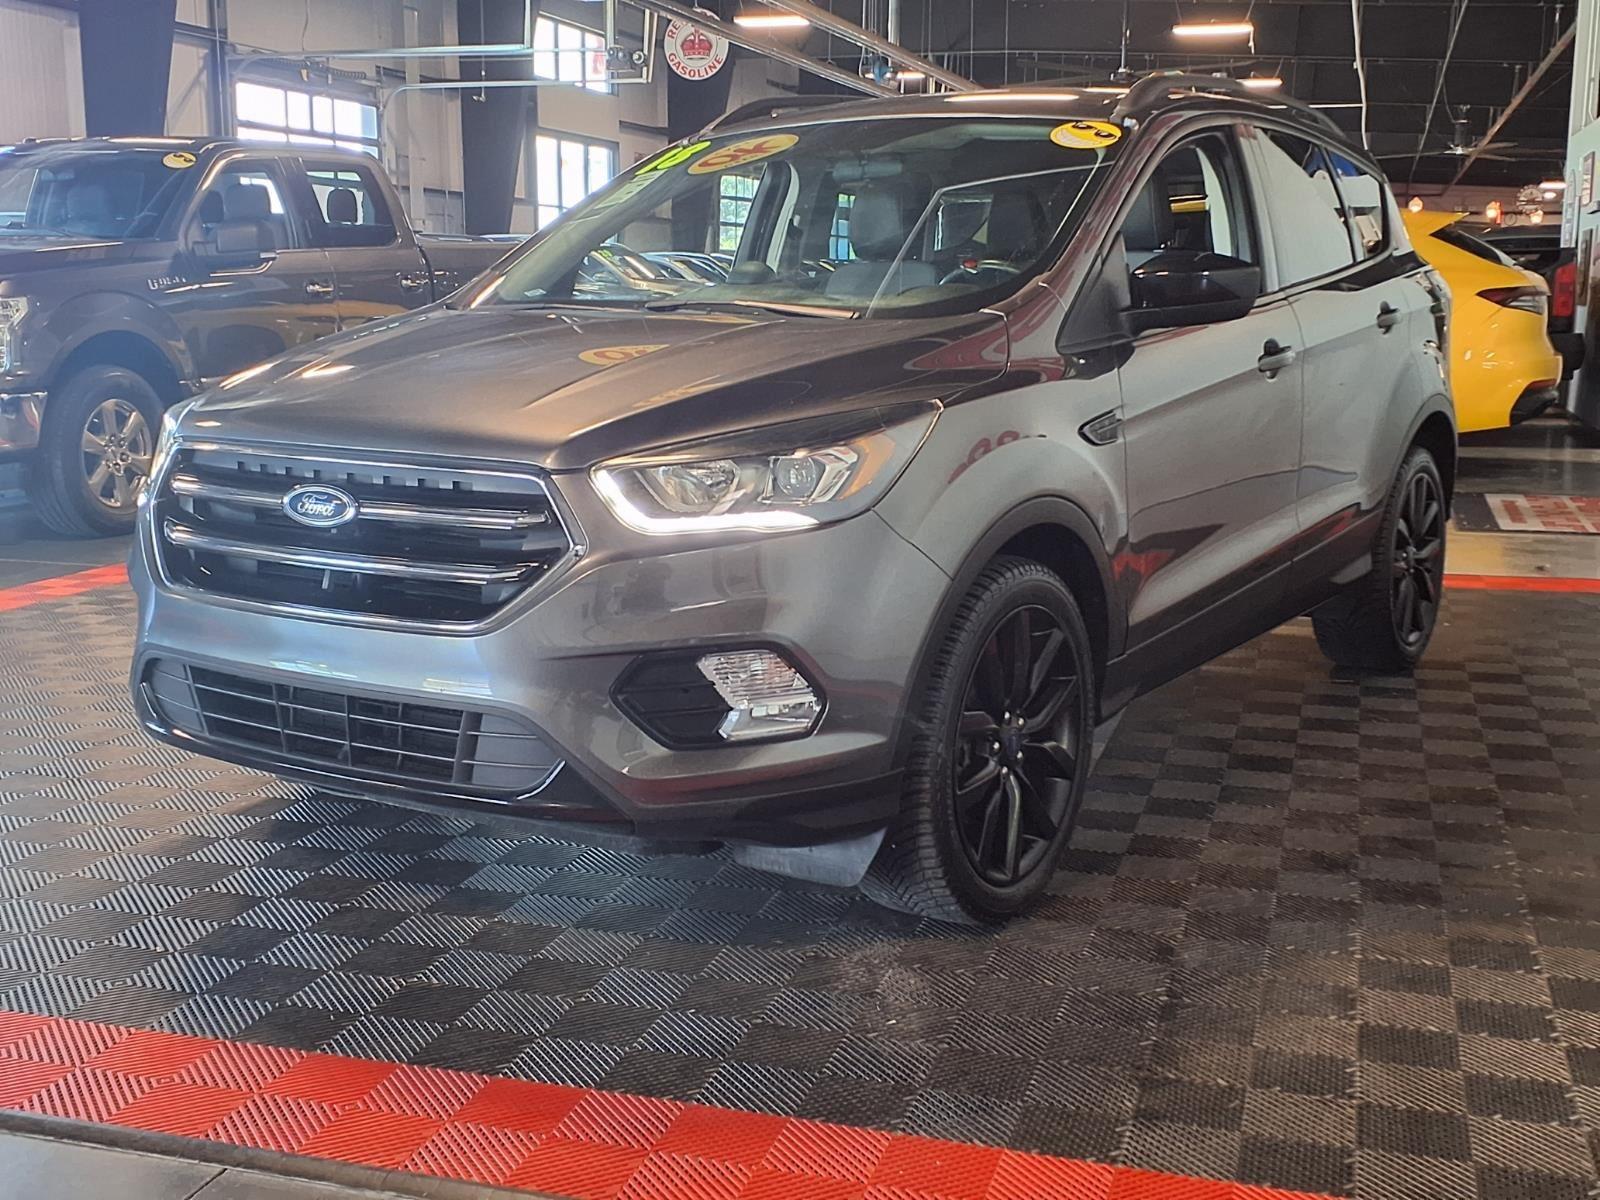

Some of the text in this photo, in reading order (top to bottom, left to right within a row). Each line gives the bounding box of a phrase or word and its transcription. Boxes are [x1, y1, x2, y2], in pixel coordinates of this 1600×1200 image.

[668, 53, 723, 78] GASOLINE
[698, 140, 780, 167] OK
[297, 493, 335, 516] Ford
